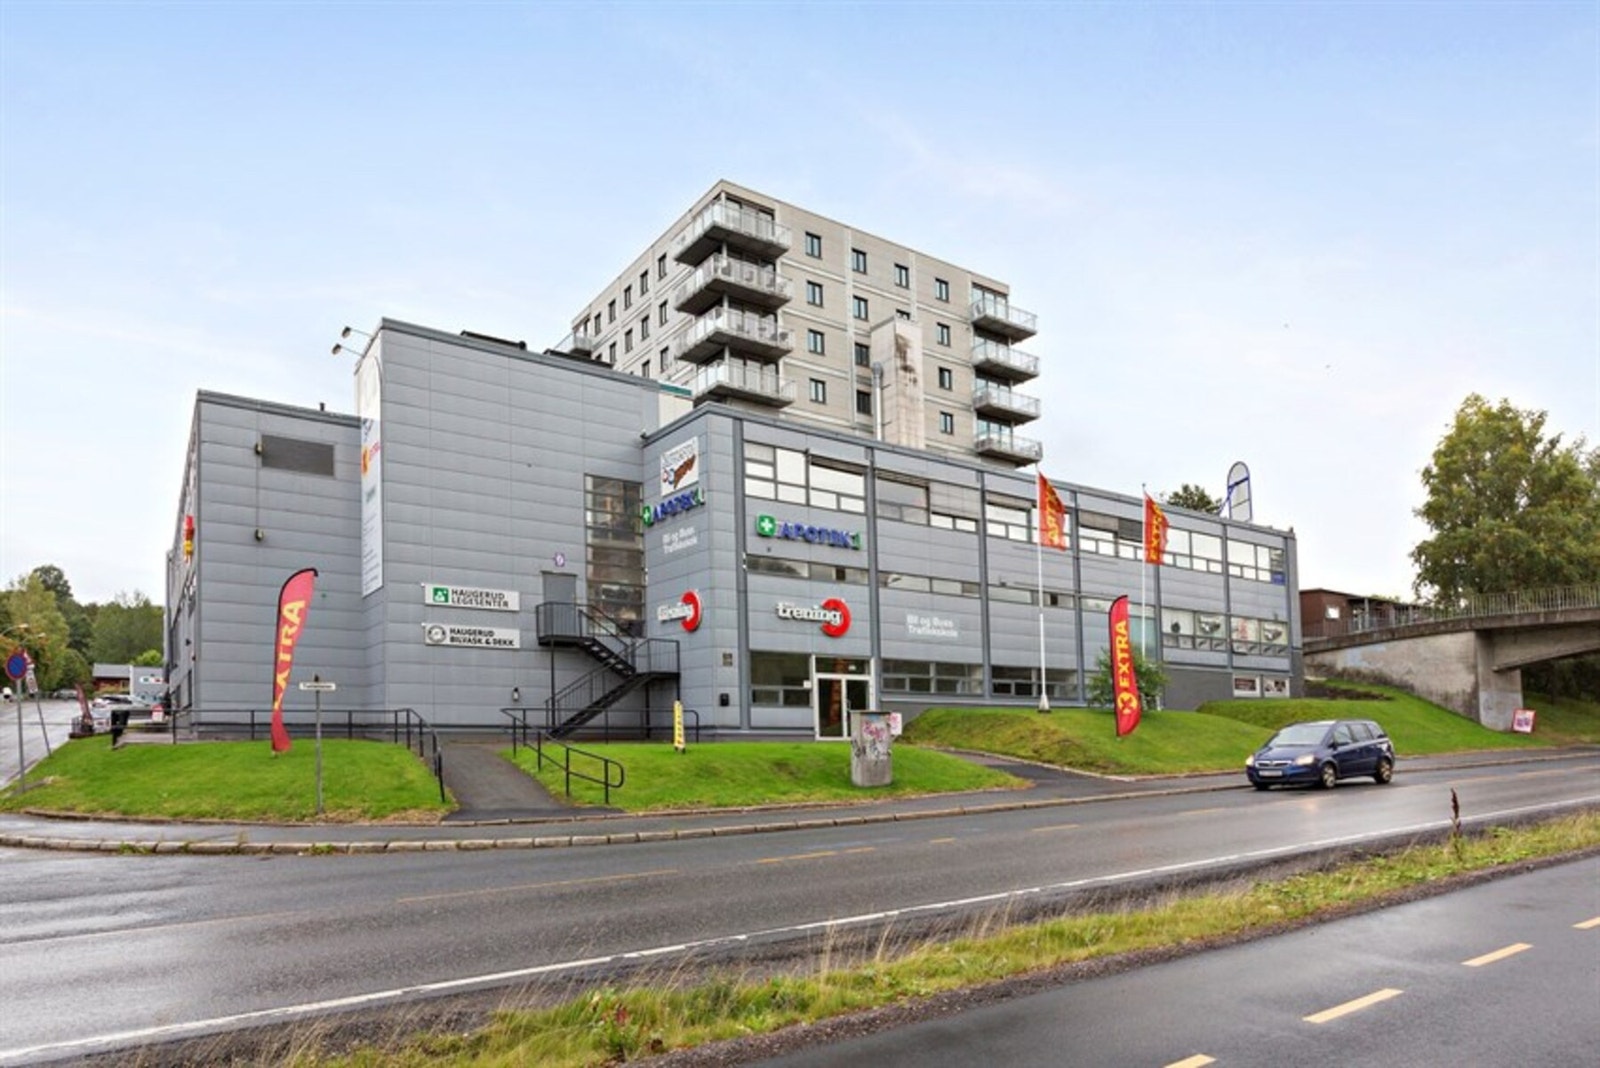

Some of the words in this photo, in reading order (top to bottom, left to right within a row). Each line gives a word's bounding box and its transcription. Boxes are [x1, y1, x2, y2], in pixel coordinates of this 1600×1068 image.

[781, 522, 852, 548] APOTEK
[451, 589, 505, 600] HAUGERUD
[451, 597, 509, 608] LEGESENTER
[776, 602, 842, 626] trening
[449, 628, 495, 637] HAUGERUD
[449, 636, 483, 645] BILVASK
[492, 639, 515, 647] DEKK
[273, 600, 306, 711] XTRA
[1115, 620, 1130, 688] EXTRA
